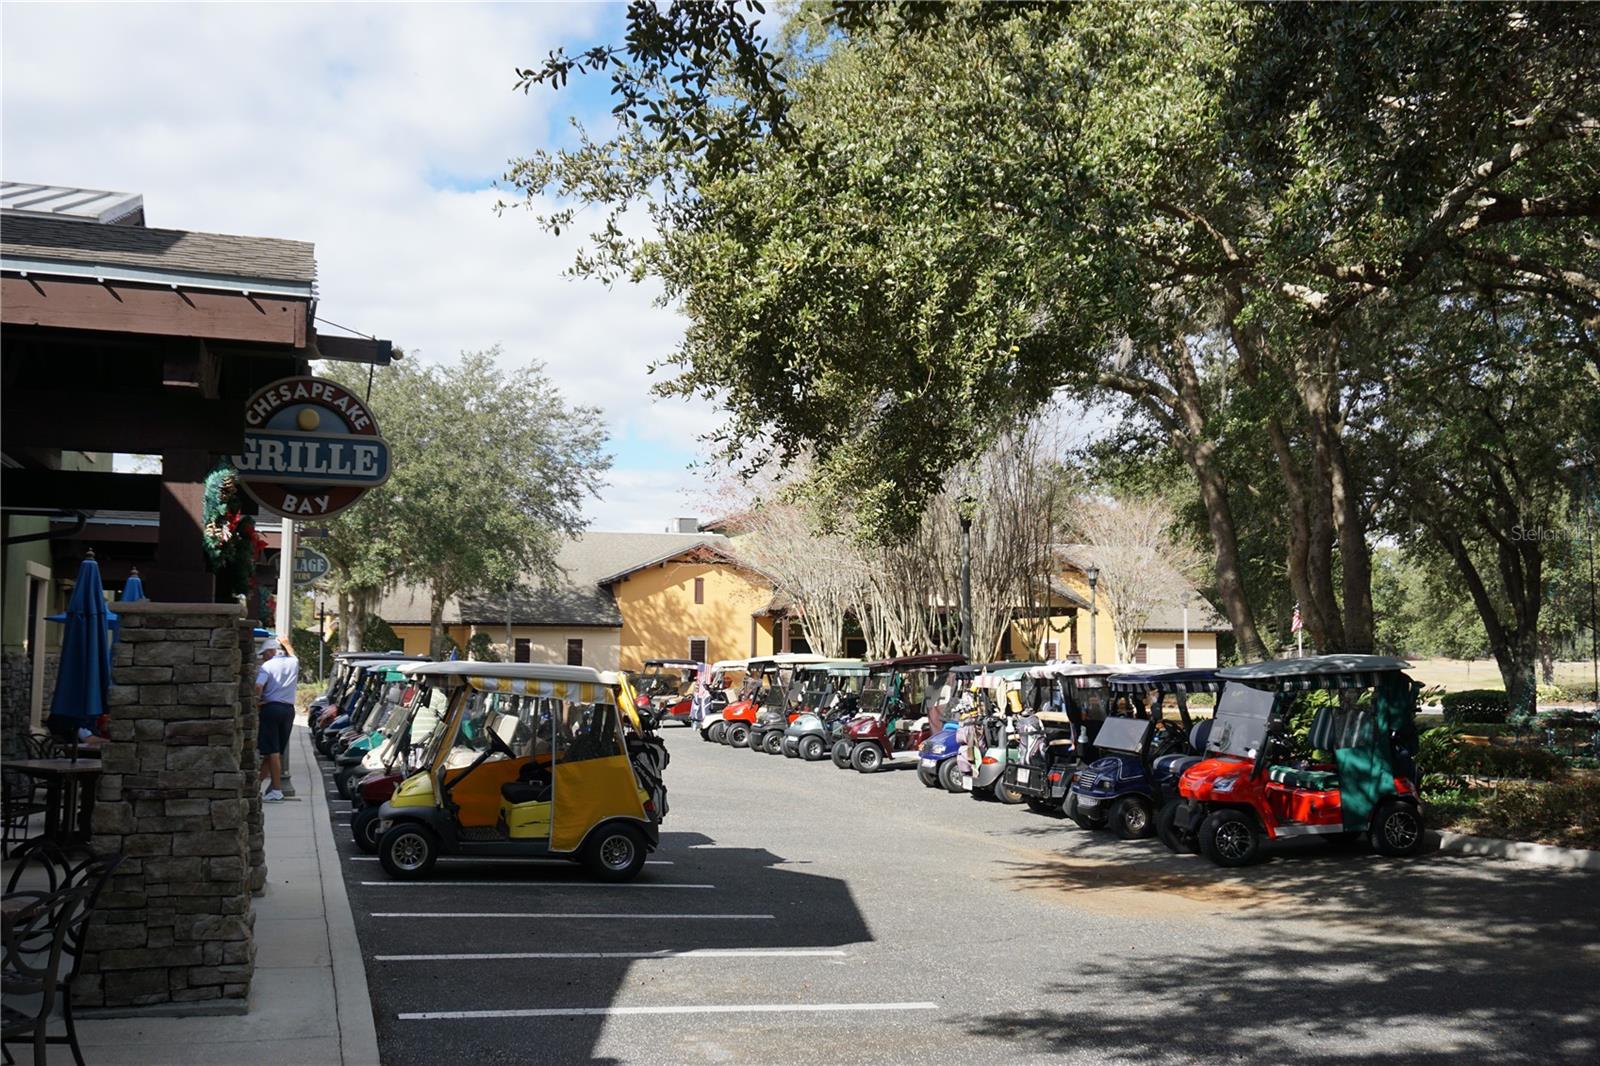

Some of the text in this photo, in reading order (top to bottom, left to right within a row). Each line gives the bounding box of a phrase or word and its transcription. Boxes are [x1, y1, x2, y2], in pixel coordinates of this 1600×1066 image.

[246, 382, 370, 431] CHESAPEAKE
[231, 437, 379, 476] GRILLE
[282, 493, 330, 514] BAY
